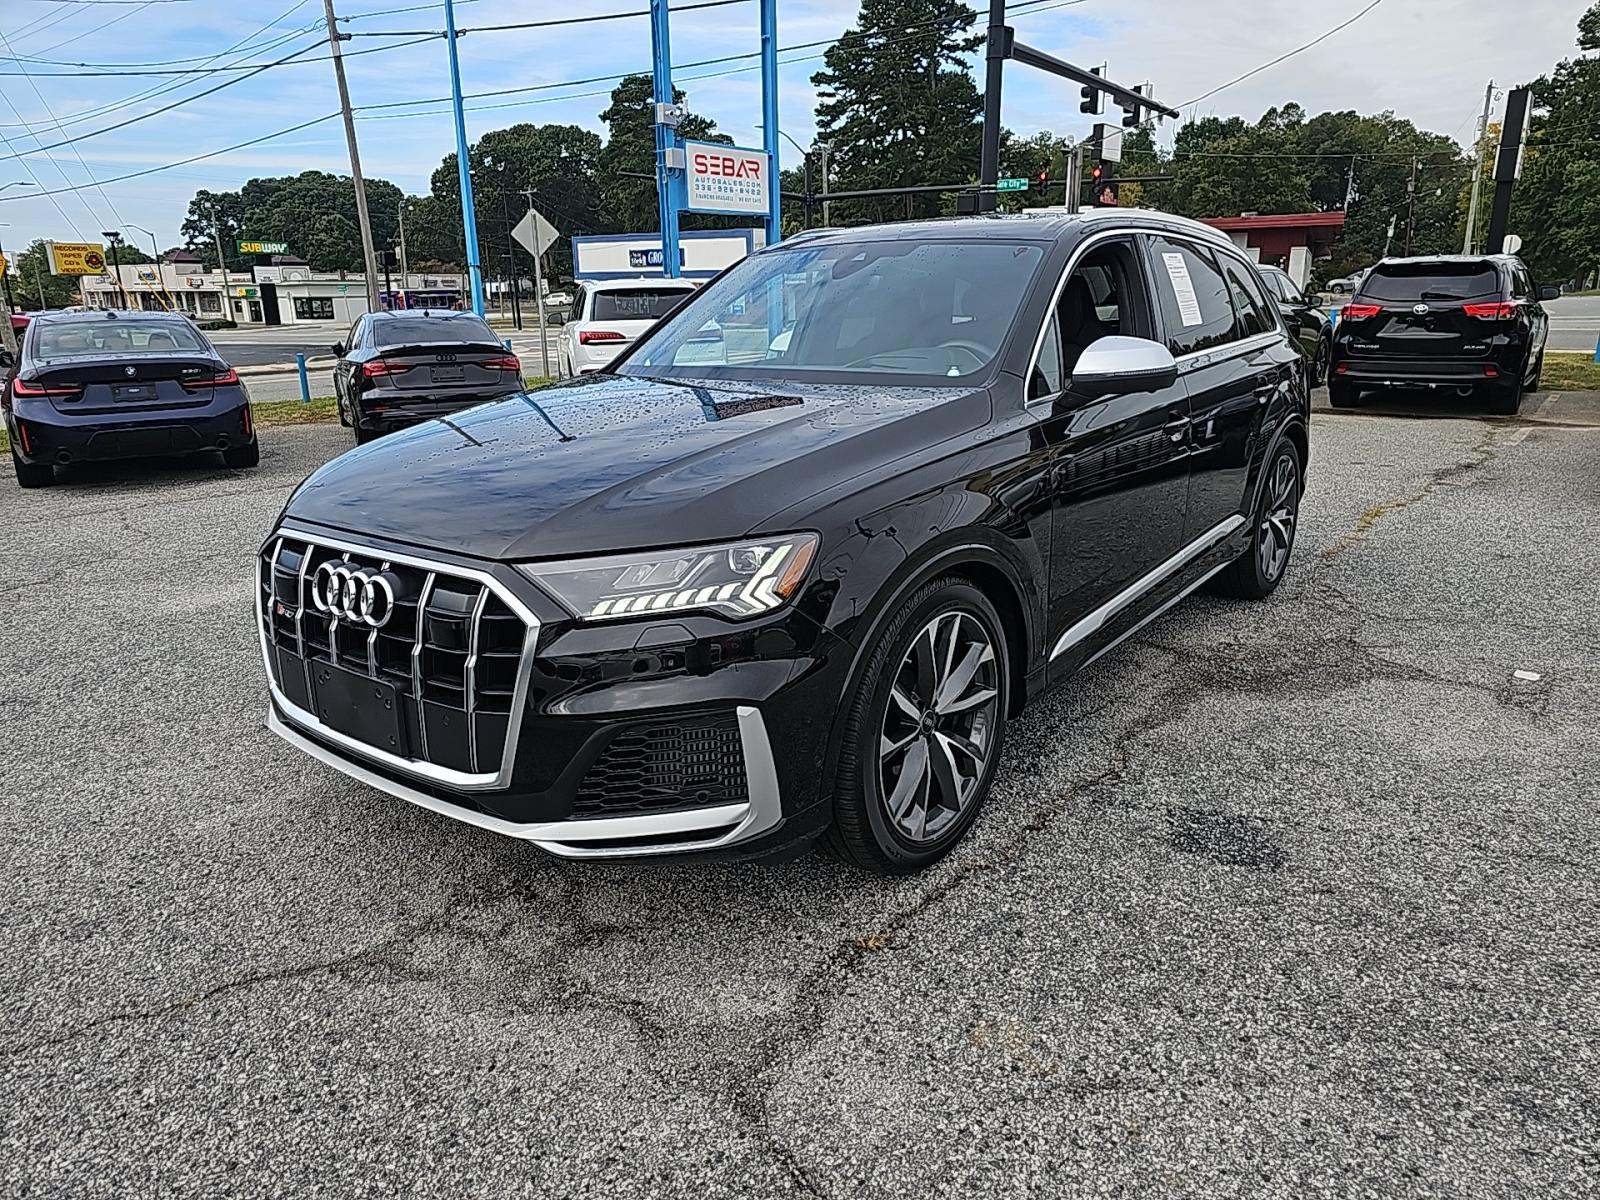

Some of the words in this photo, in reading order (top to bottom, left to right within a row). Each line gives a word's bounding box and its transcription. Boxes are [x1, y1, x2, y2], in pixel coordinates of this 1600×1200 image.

[694, 154, 760, 179] SEBAR
[695, 177, 761, 188] AUTOSALES.COM
[1009, 179, 1020, 188] City
[240, 242, 287, 253] SUBWAY
